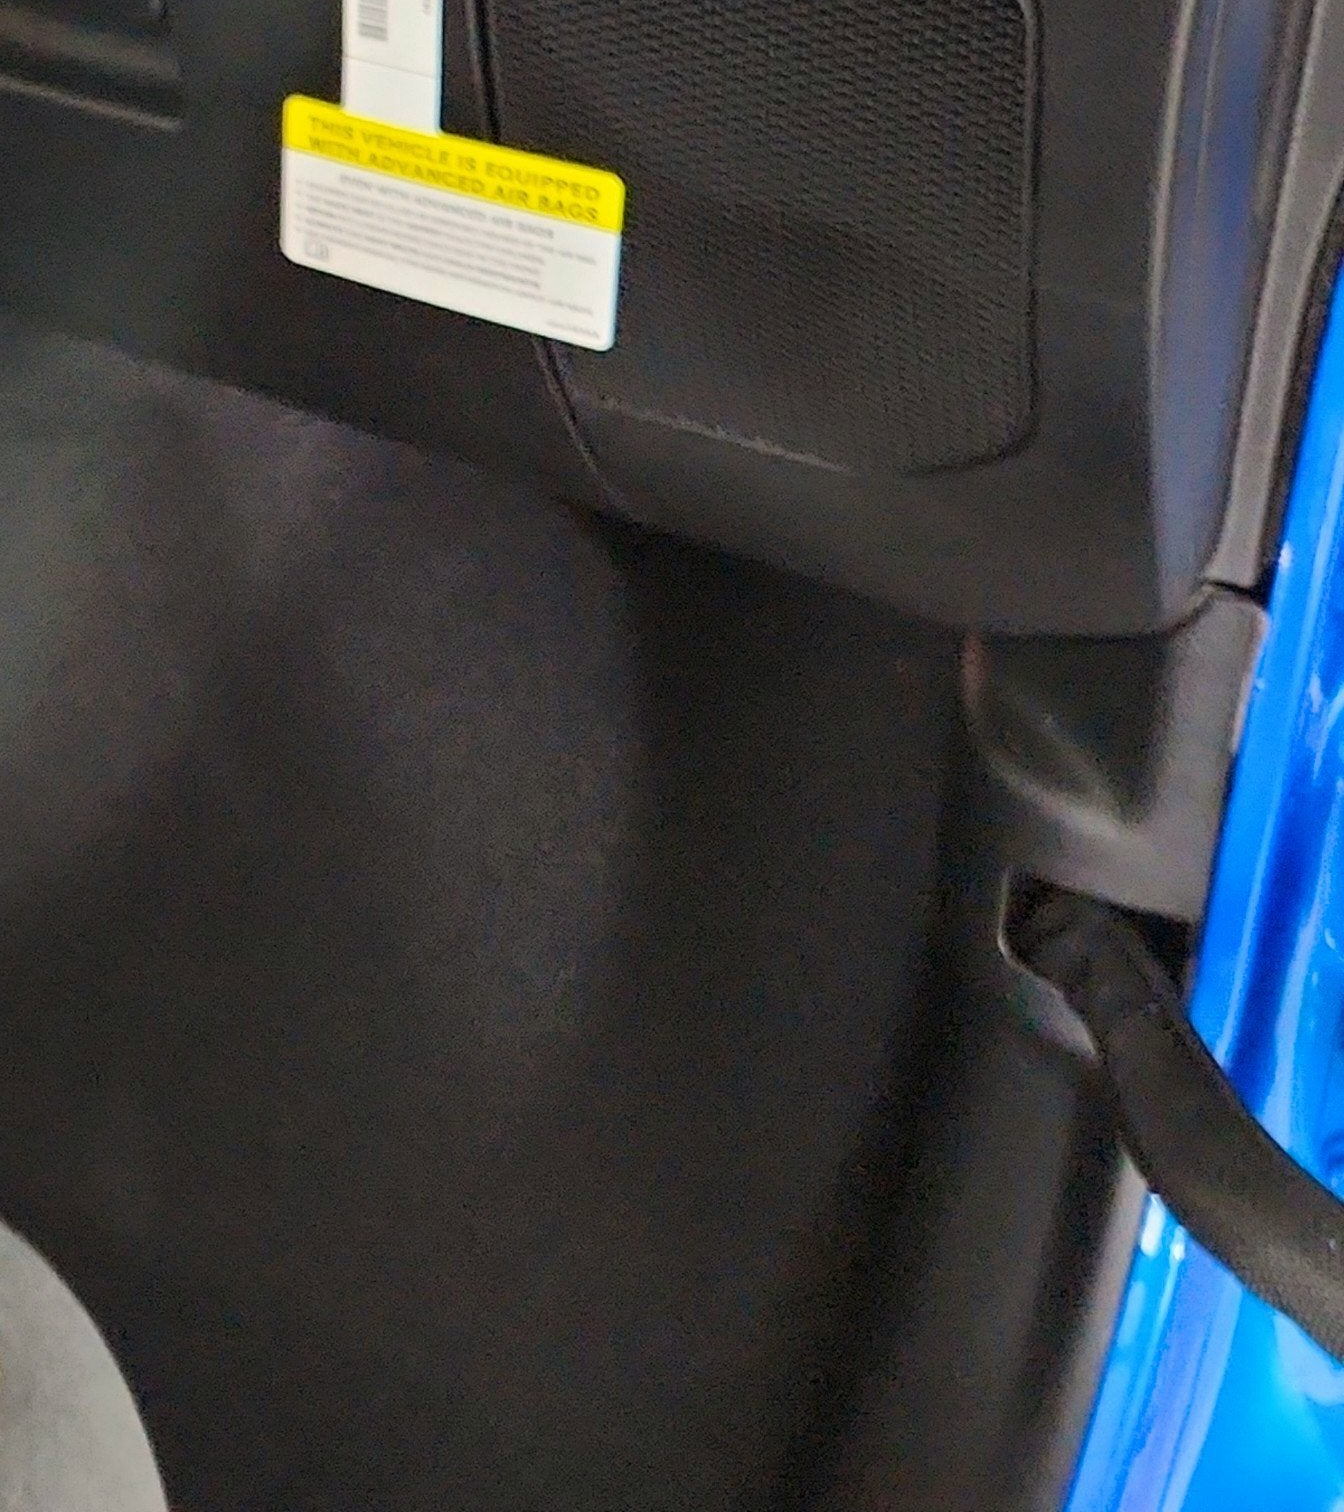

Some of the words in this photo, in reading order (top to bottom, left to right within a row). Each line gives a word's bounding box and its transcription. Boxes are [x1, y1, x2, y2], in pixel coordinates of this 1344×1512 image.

[309, 115, 354, 138] THIS
[362, 131, 449, 165] VEHICLE
[458, 154, 477, 172] IS
[485, 161, 601, 202] EQUIPPED
[368, 151, 486, 195] ADVANCED
[495, 185, 530, 207] AIR
[538, 194, 599, 223] BAGS
